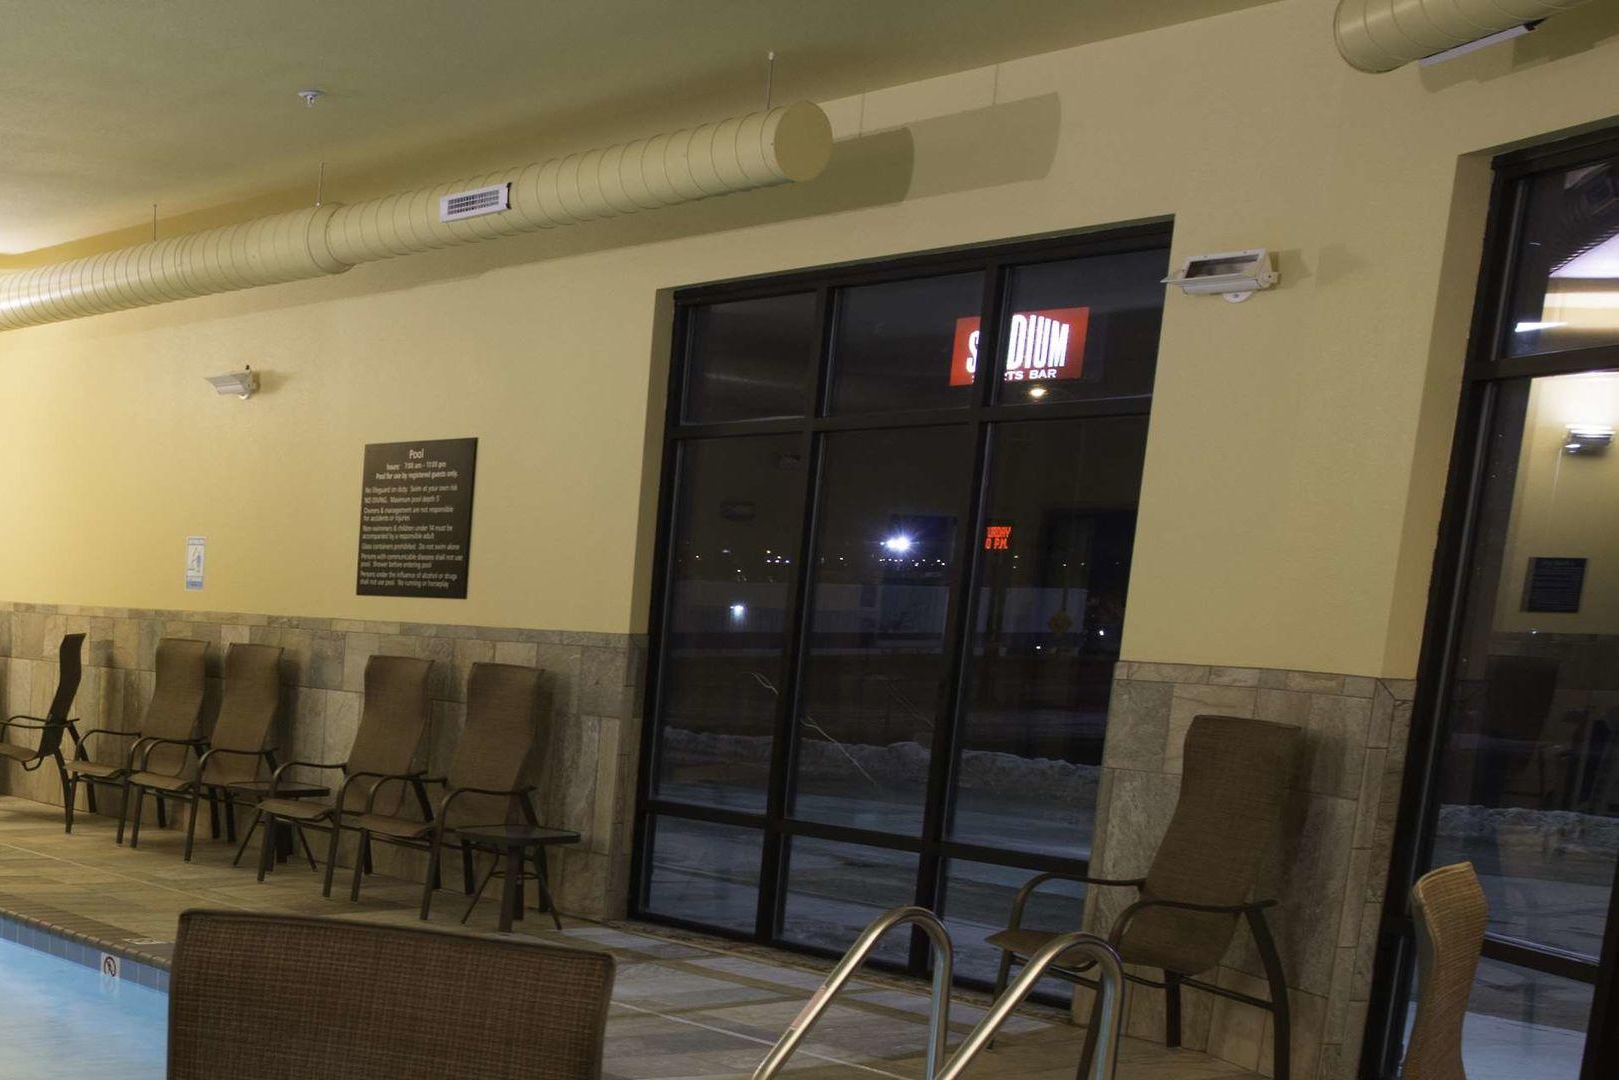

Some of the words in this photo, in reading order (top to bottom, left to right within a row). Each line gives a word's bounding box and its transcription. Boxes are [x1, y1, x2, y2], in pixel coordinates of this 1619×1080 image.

[966, 315, 1069, 373] SDIUM
[1029, 369, 1057, 379] BAR
[409, 448, 424, 459] Pool
